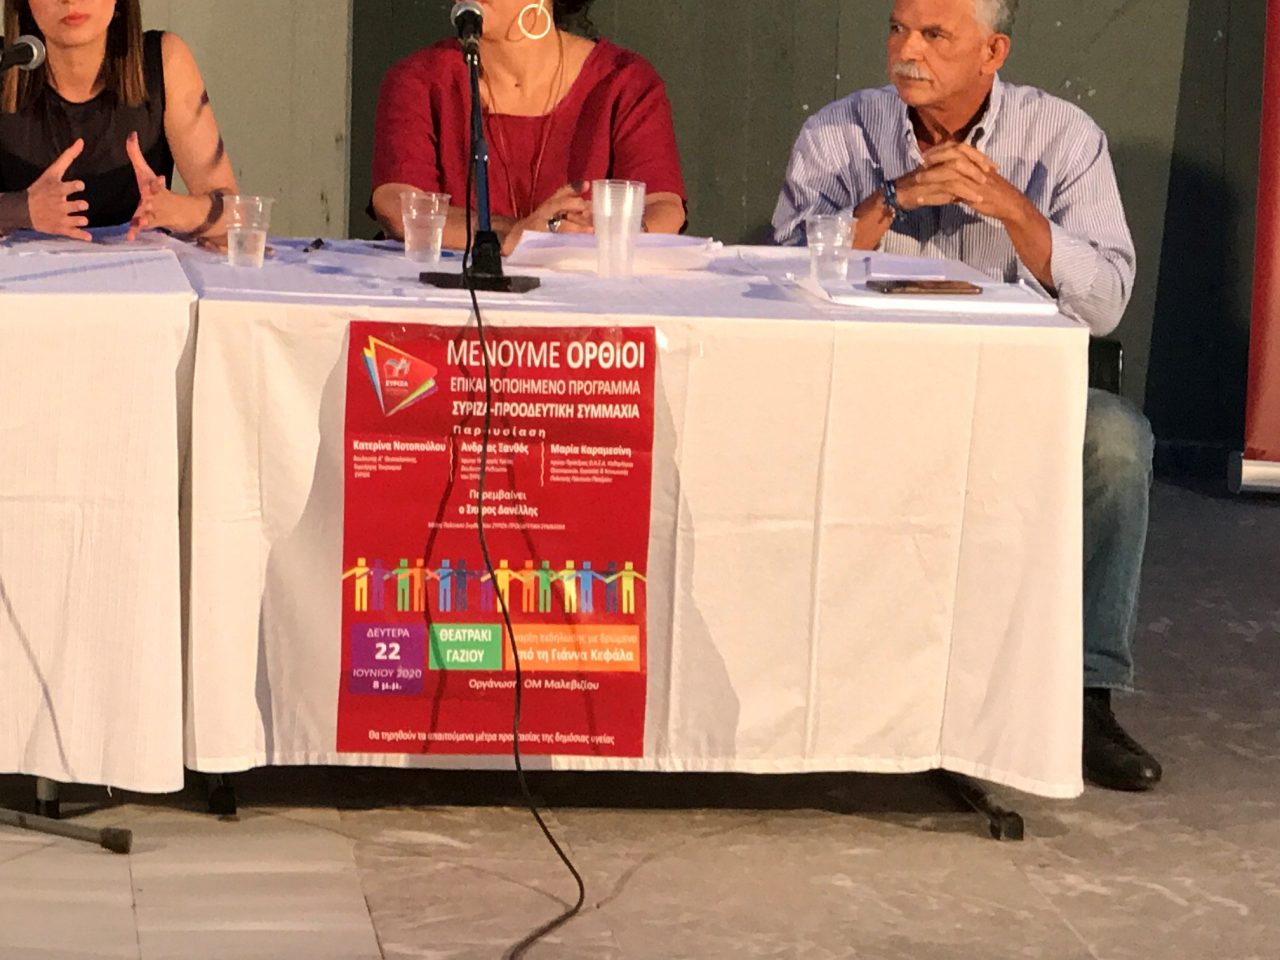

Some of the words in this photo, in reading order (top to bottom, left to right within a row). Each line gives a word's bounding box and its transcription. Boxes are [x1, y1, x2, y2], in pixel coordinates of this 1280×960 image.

[447, 339, 560, 368] ΜΕΝΟΥΜΕ
[566, 341, 645, 369] ΟΡΘΙΟΙ
[569, 380, 640, 395] ΠΡΟΓΡΑΜΜΑ
[577, 403, 640, 419] ΣΥΜΜΑΧΙΑ
[453, 425, 546, 438] Παρυσίαση
[353, 440, 391, 452] Κατερίνα
[393, 441, 446, 452] Νοτοπούλου
[461, 442, 497, 454] Ανδρας
[550, 444, 579, 455] Μαρία
[581, 444, 632, 458] Καραμεσίνη
[366, 628, 410, 638] ΔΕΥΤΕΡΑ
[439, 628, 492, 642] ΘΕΑΤΡΑΚΙ
[375, 642, 401, 660] 22
[446, 649, 485, 662] ΓΑΖΙΟΥ
[536, 650, 549, 663] τη
[551, 647, 587, 661] Γιάννα
[590, 648, 634, 663] Κεφάλα
[353, 668, 394, 678] ΙΟΥΝΙΟΥ
[396, 668, 422, 679] 2020
[372, 680, 379, 689] 8
[524, 679, 541, 688] ΟΜ
